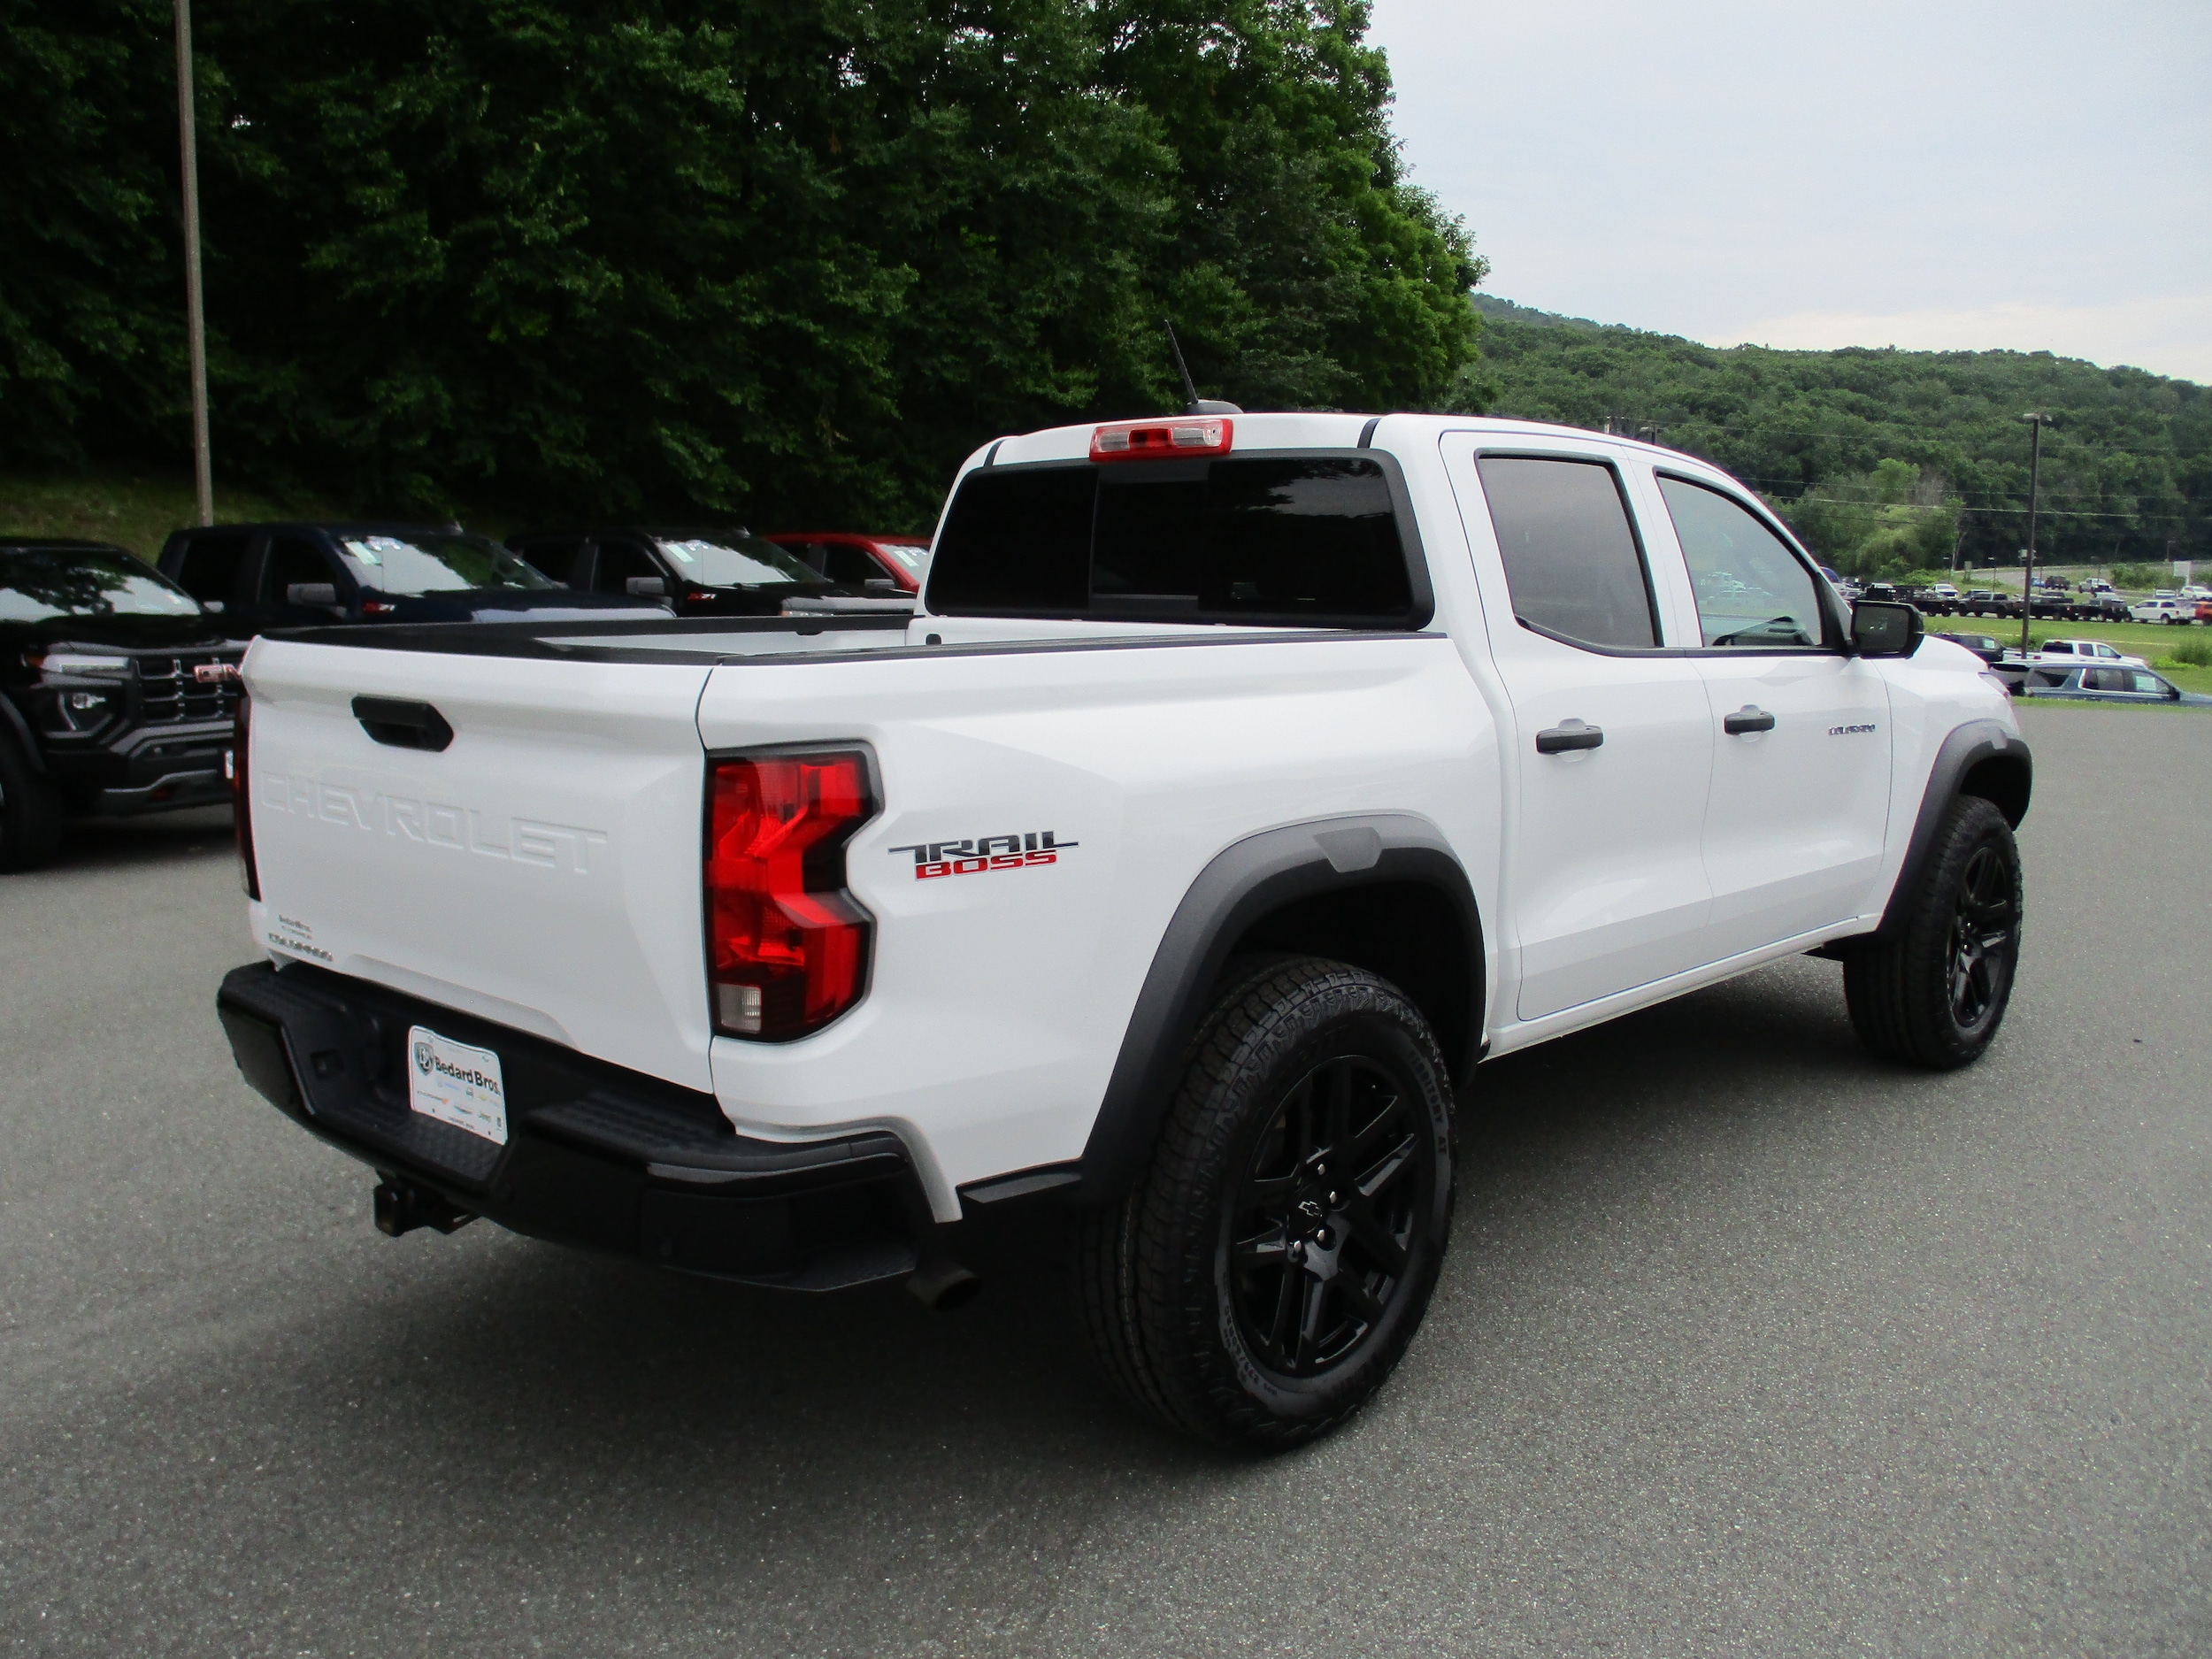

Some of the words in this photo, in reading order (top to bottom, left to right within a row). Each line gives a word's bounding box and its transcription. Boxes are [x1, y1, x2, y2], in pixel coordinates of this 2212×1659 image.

[194, 664, 243, 683] GM
[262, 771, 608, 874] CHEVROLET
[887, 831, 1079, 864] TRAIL
[916, 849, 1057, 879] BOSS
[434, 1056, 473, 1084] Bedard
[474, 1071, 501, 1096] Bros.
